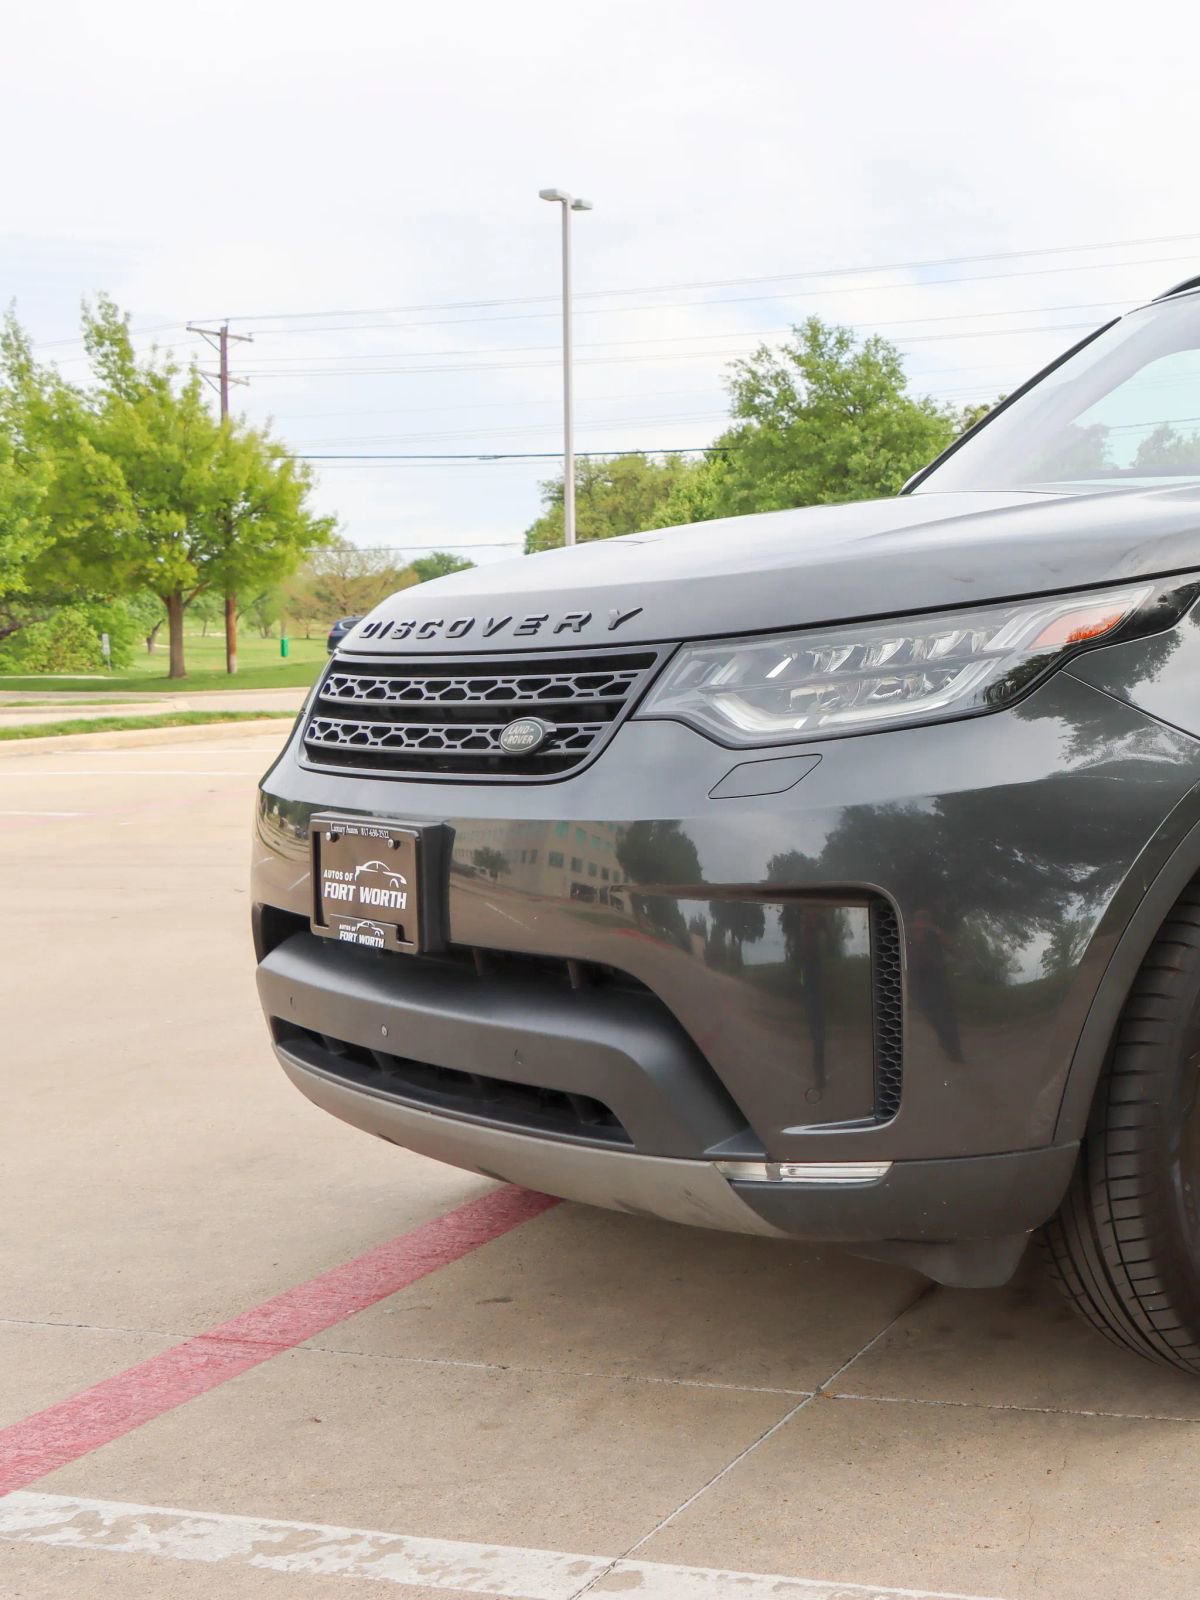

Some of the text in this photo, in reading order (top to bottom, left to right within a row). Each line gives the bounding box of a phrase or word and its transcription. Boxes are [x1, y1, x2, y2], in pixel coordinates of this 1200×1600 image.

[358, 607, 643, 640] DISCOVERY
[323, 869, 354, 881] AUTOS OF
[324, 881, 407, 909] FORT WORTH
[340, 931, 384, 948] FORT WORTH
